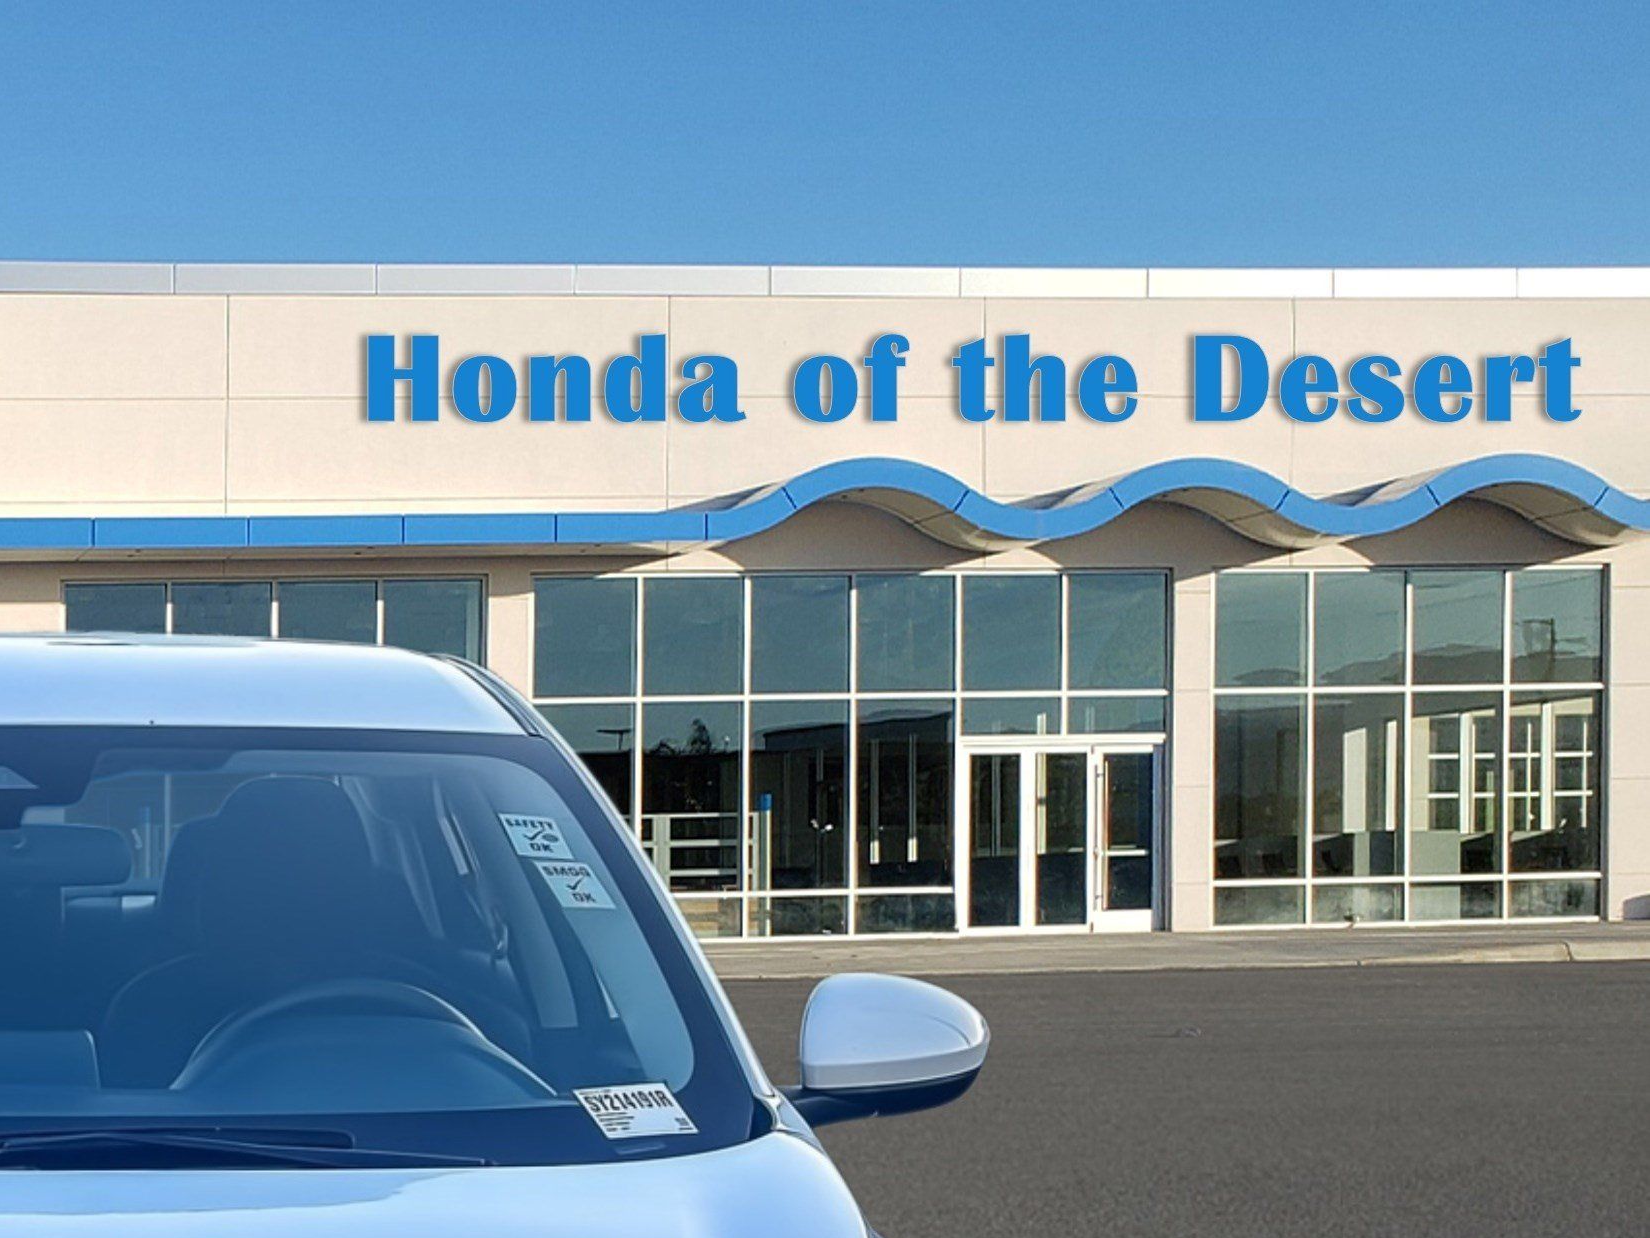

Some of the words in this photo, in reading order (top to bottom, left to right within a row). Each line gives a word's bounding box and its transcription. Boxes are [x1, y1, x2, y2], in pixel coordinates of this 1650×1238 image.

[366, 334, 746, 422] Honda
[793, 334, 910, 422] of
[952, 334, 1138, 422] the
[1193, 334, 1582, 422] Desert
[505, 817, 554, 830] SAFETY
[530, 842, 554, 853] OK
[542, 865, 593, 877] SMOG
[572, 892, 596, 903] OK
